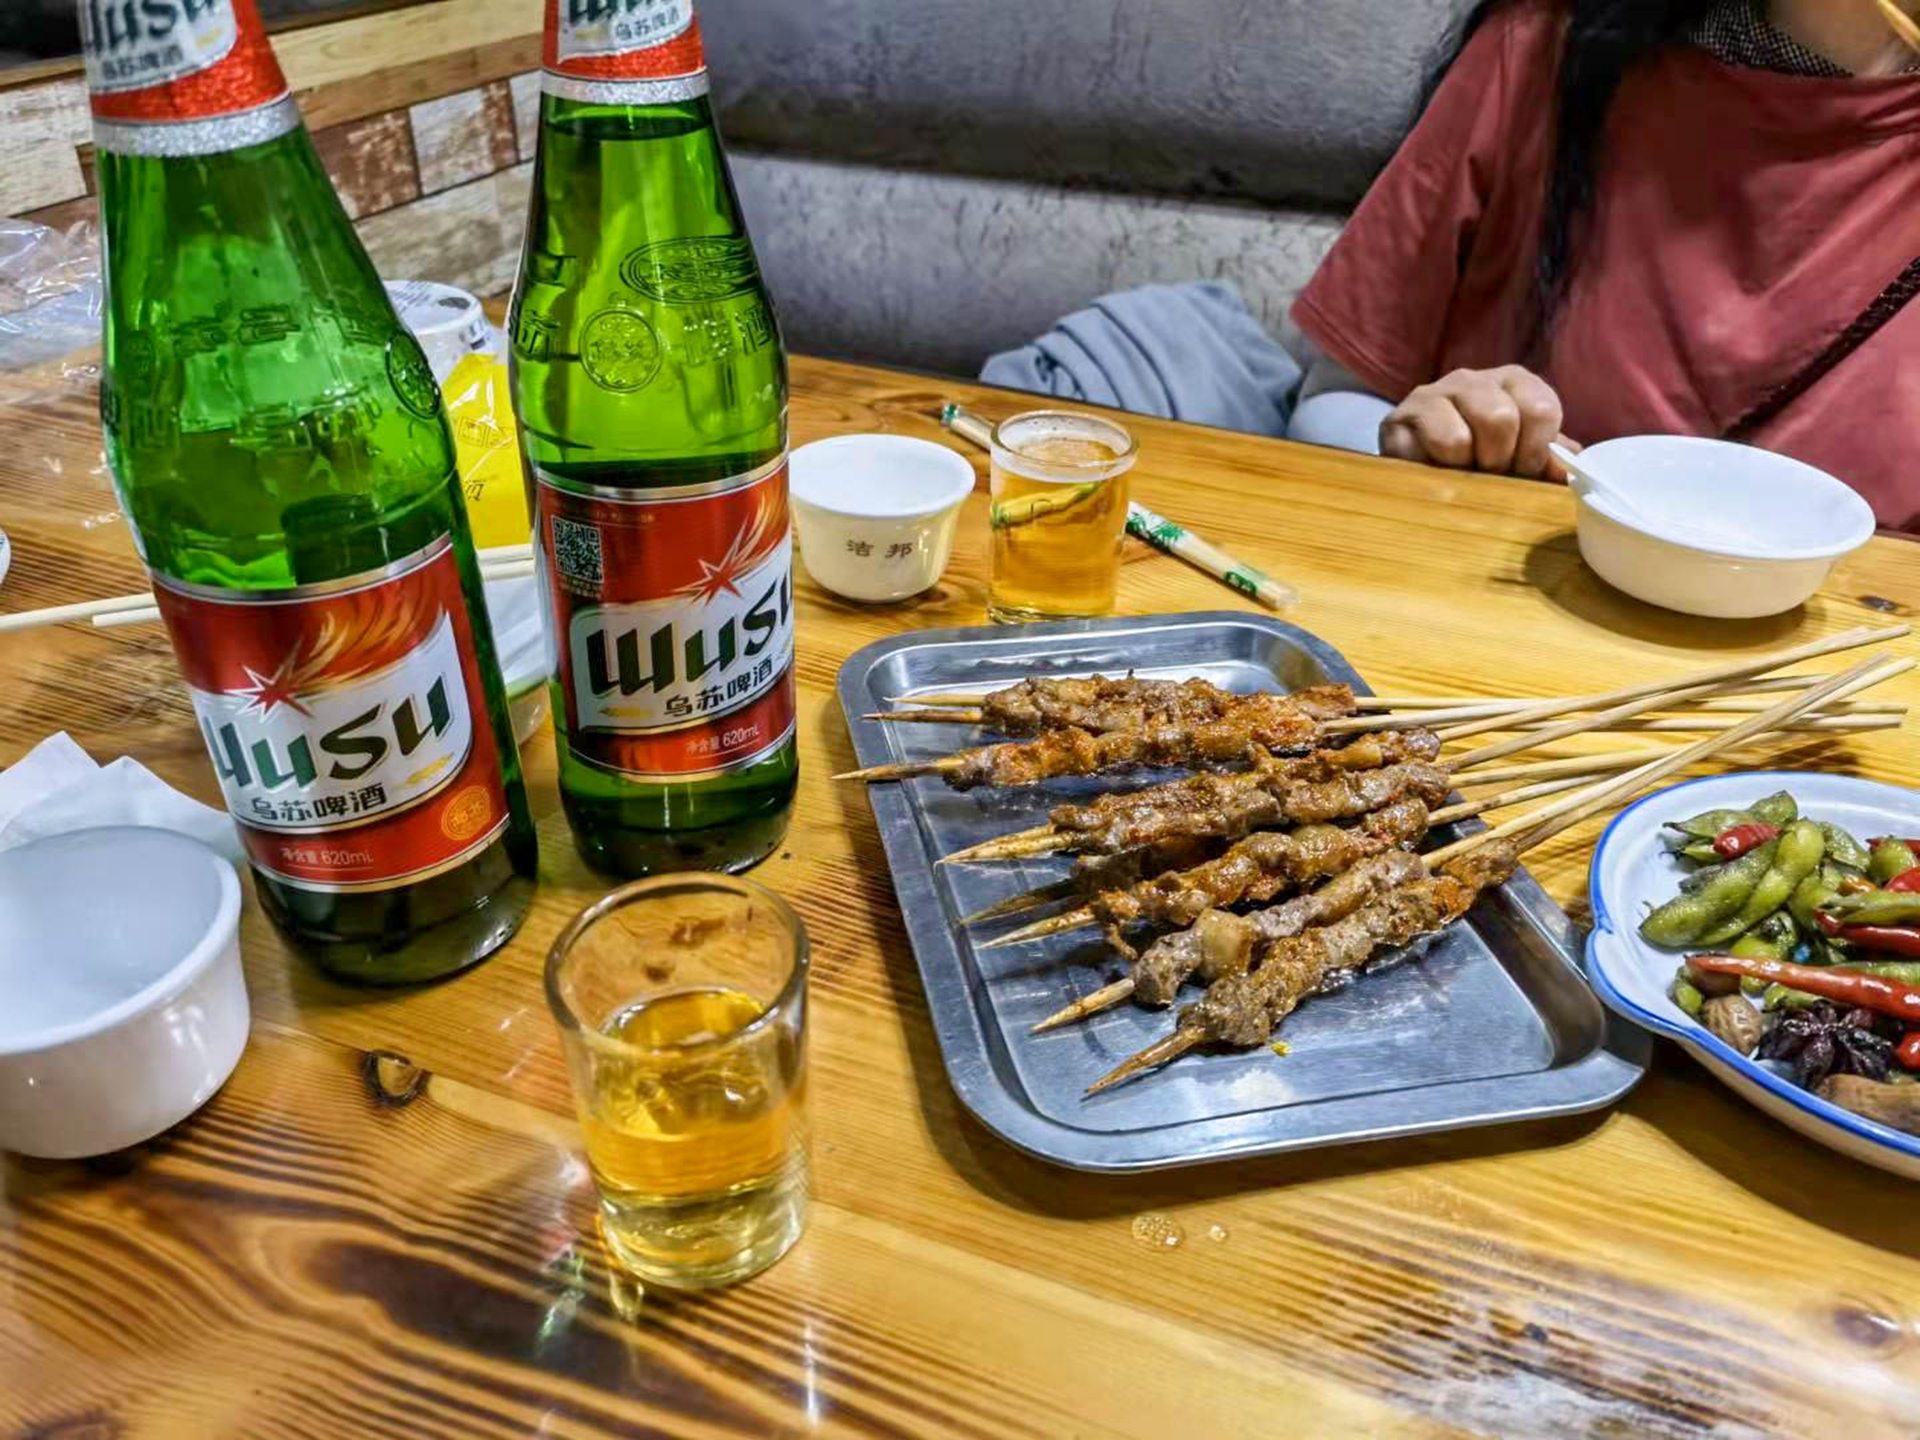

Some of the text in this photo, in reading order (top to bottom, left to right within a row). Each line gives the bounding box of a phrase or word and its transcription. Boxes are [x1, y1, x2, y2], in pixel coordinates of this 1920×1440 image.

[663, 653, 773, 718] 乌苏啤酒
[251, 781, 387, 822] 乌苏啤酒
